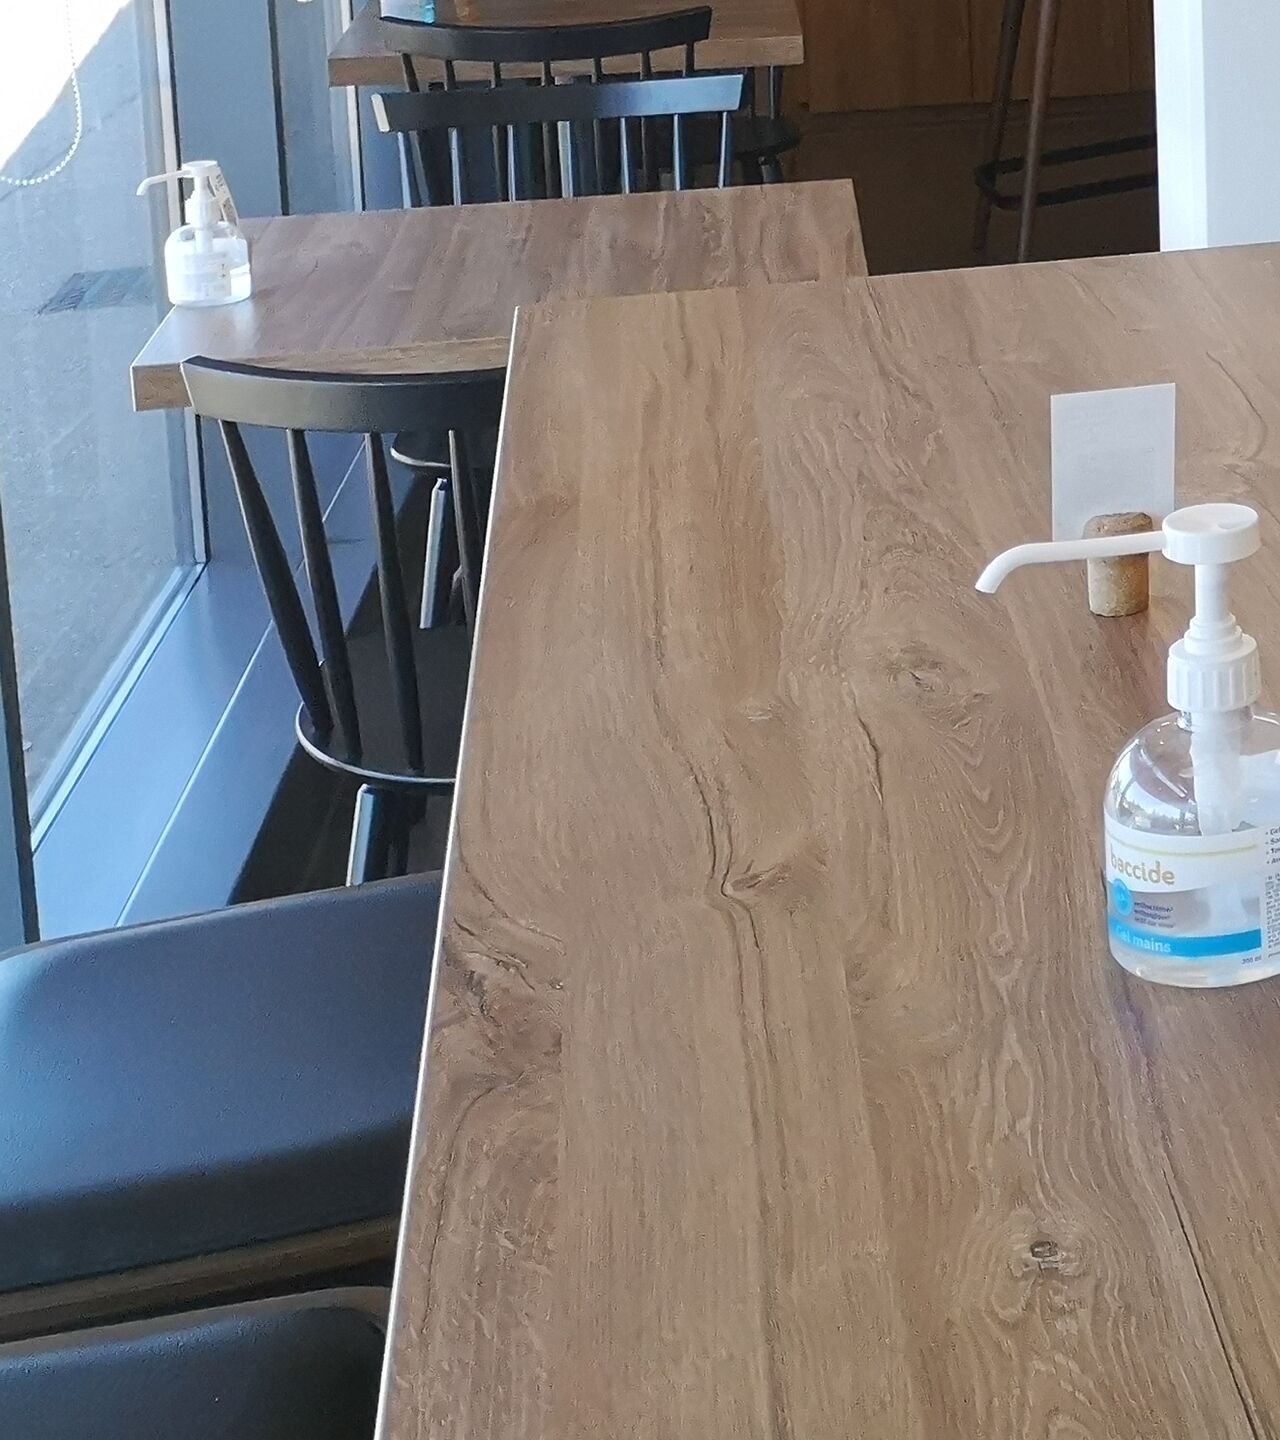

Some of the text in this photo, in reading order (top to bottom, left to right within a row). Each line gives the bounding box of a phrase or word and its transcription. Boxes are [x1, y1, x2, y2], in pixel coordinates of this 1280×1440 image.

[1110, 842, 1176, 886] baccide
[1116, 922, 1131, 943] Gel
[1132, 935, 1172, 954] mains
